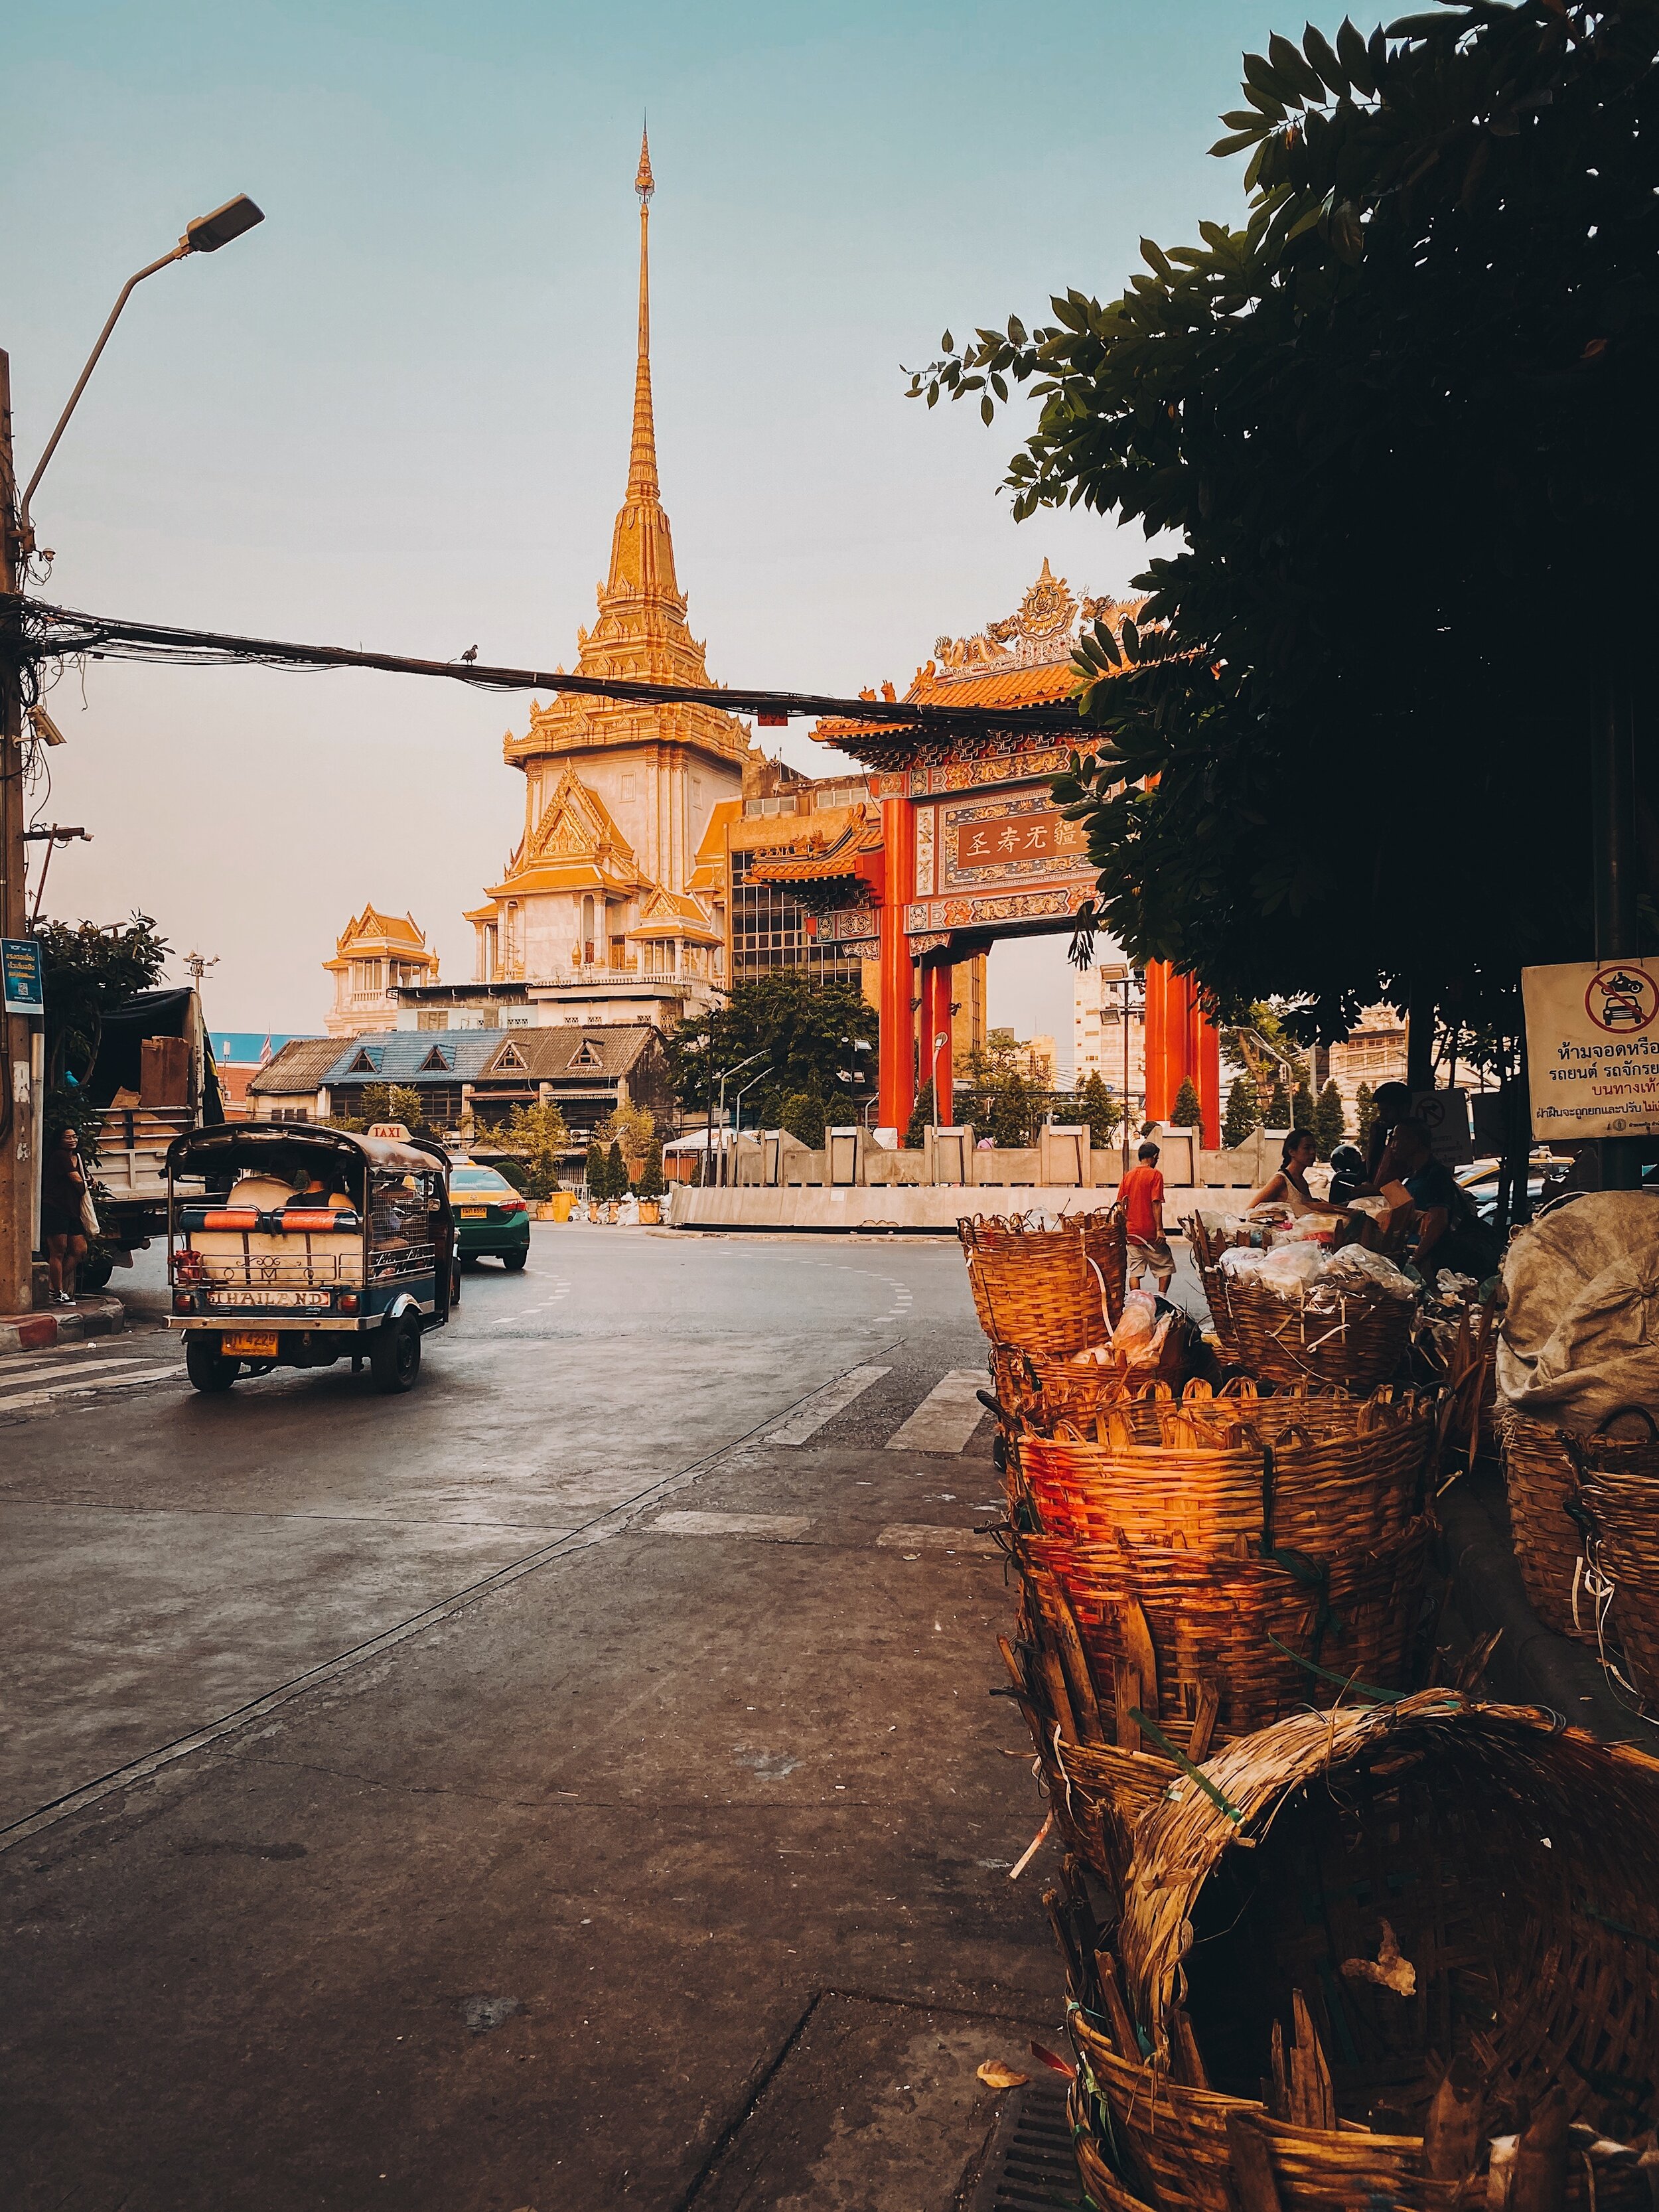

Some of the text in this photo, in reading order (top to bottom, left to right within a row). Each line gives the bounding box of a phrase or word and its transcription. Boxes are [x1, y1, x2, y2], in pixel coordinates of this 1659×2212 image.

[1557, 1037, 1659, 1060] ห้ามจอดหรือ
[1550, 1062, 1597, 1080] รถยนต์
[373, 1127, 400, 1138] TAXI
[216, 1292, 323, 1305] THAILAND
